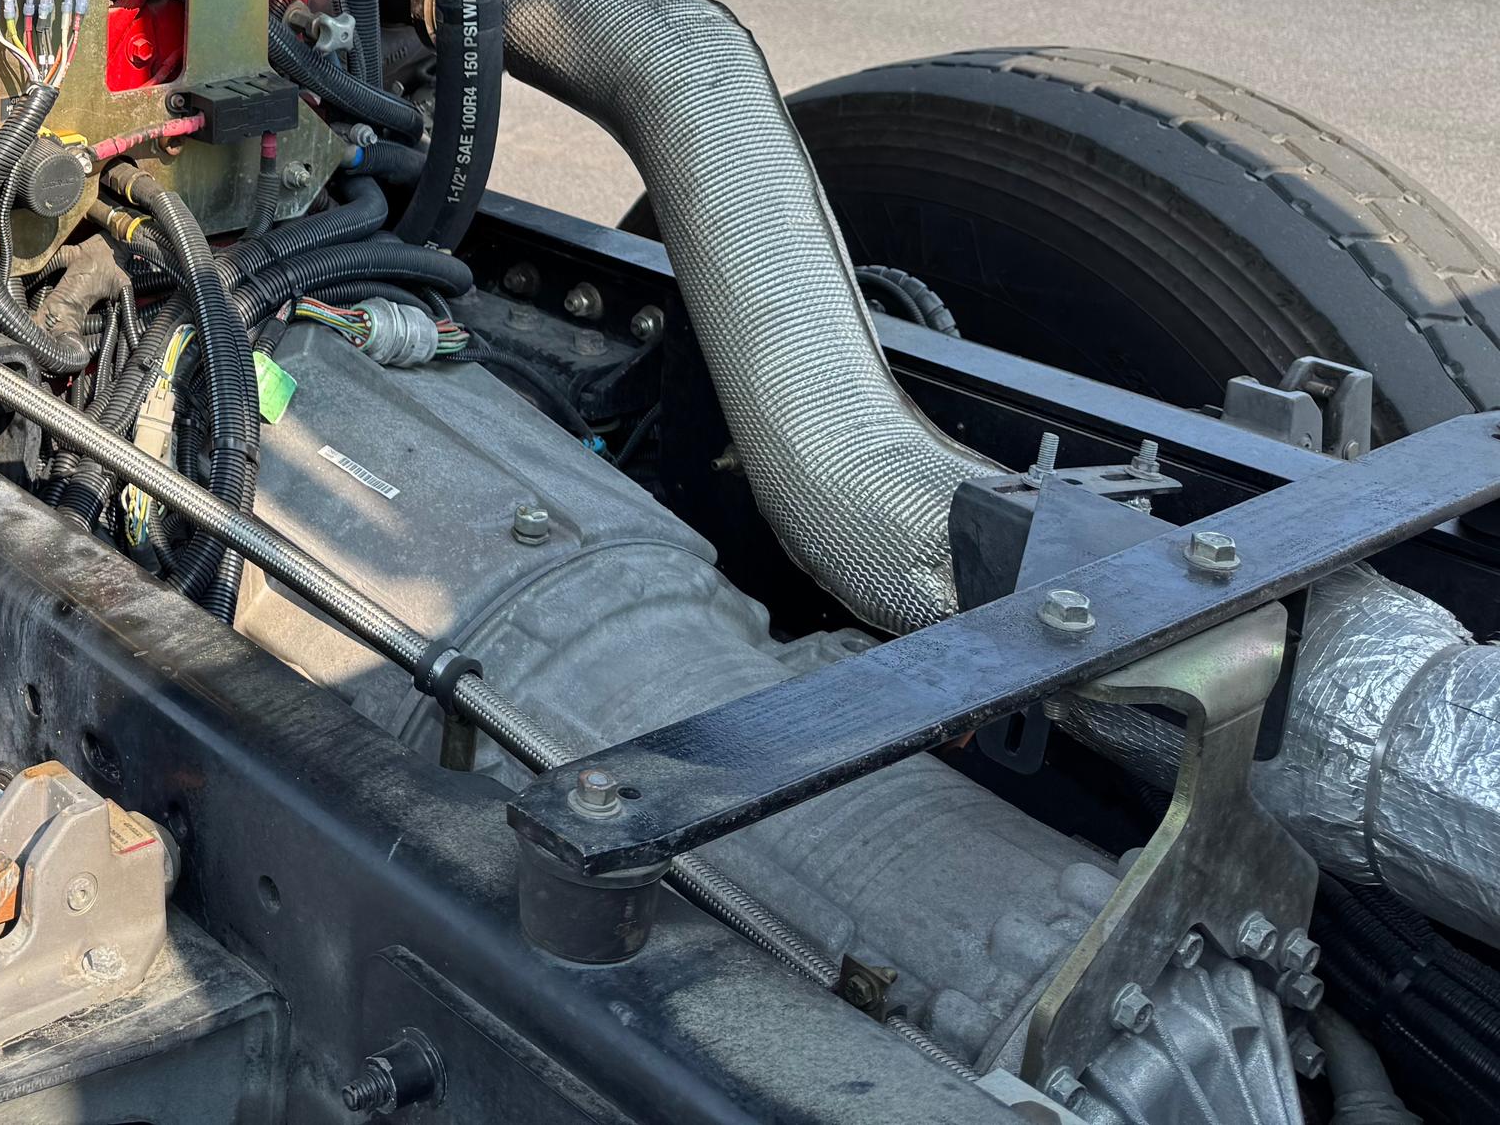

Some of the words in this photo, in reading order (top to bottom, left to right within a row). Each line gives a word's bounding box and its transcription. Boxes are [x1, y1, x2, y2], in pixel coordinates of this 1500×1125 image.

[464, 21, 478, 47] PSI
[464, 52, 478, 78] 150
[463, 86, 477, 131] 100R4
[457, 134, 475, 164] SAE
